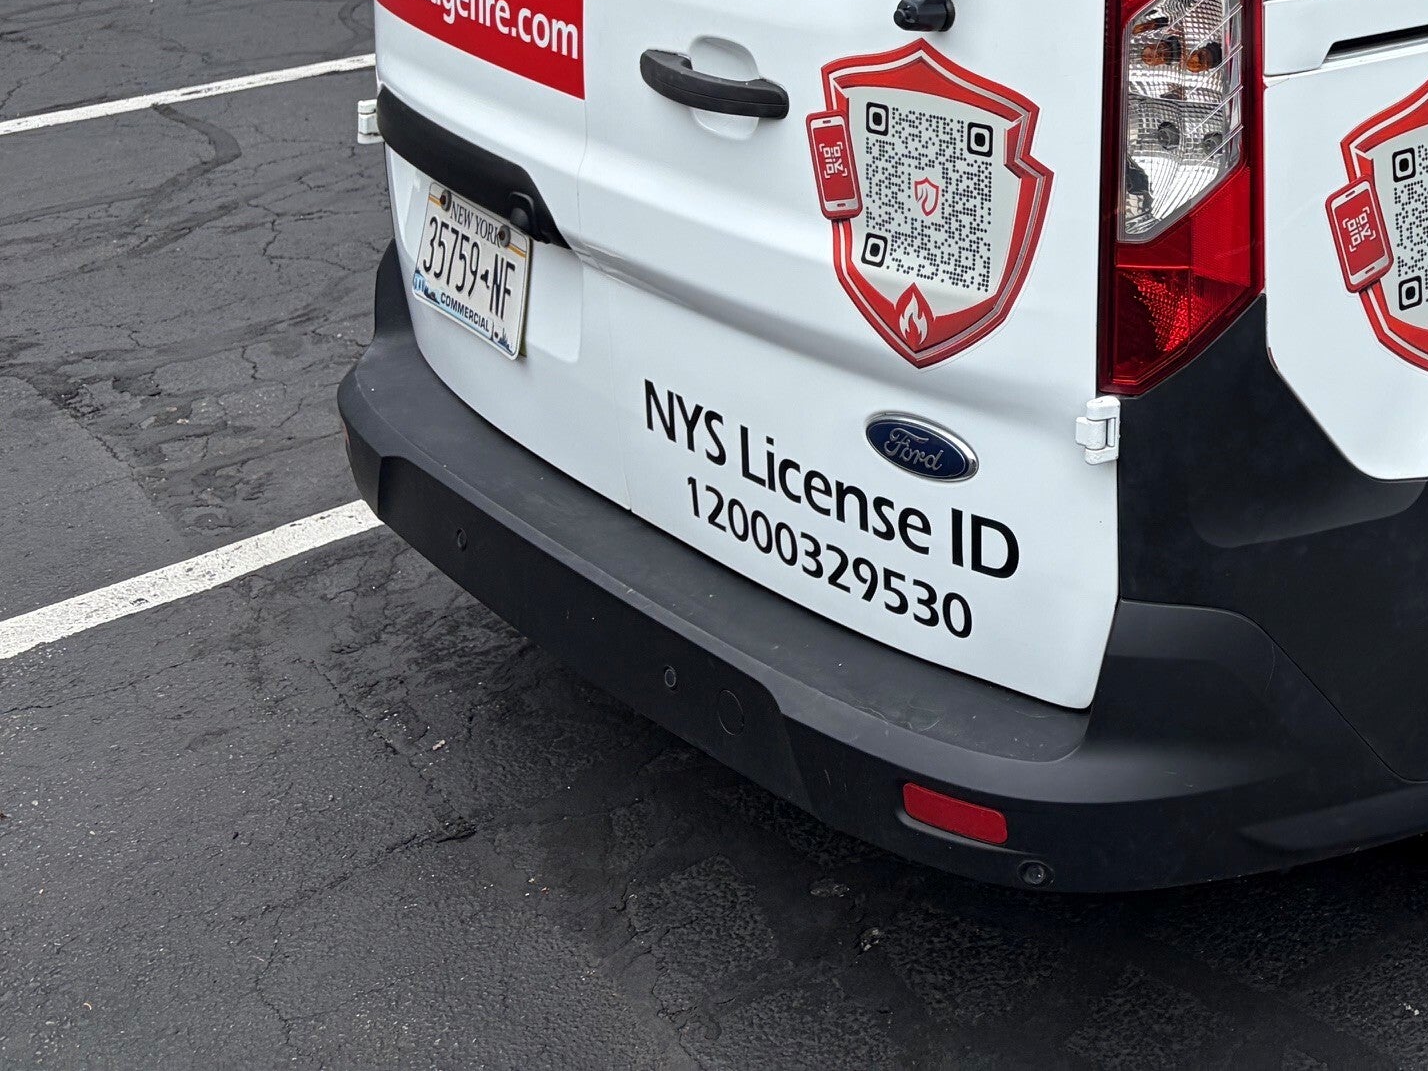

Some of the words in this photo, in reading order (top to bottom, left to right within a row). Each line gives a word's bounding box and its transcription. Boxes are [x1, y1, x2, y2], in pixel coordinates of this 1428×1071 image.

[450, 201, 474, 230] NEW
[475, 213, 501, 248] YORK
[422, 216, 481, 300] 35759
[440, 291, 490, 332] COMMERCIAL
[643, 378, 728, 467] NYS
[740, 425, 933, 556] License
[950, 507, 1020, 580] ID
[884, 427, 945, 472] Ford
[687, 475, 974, 640] 12000329530
